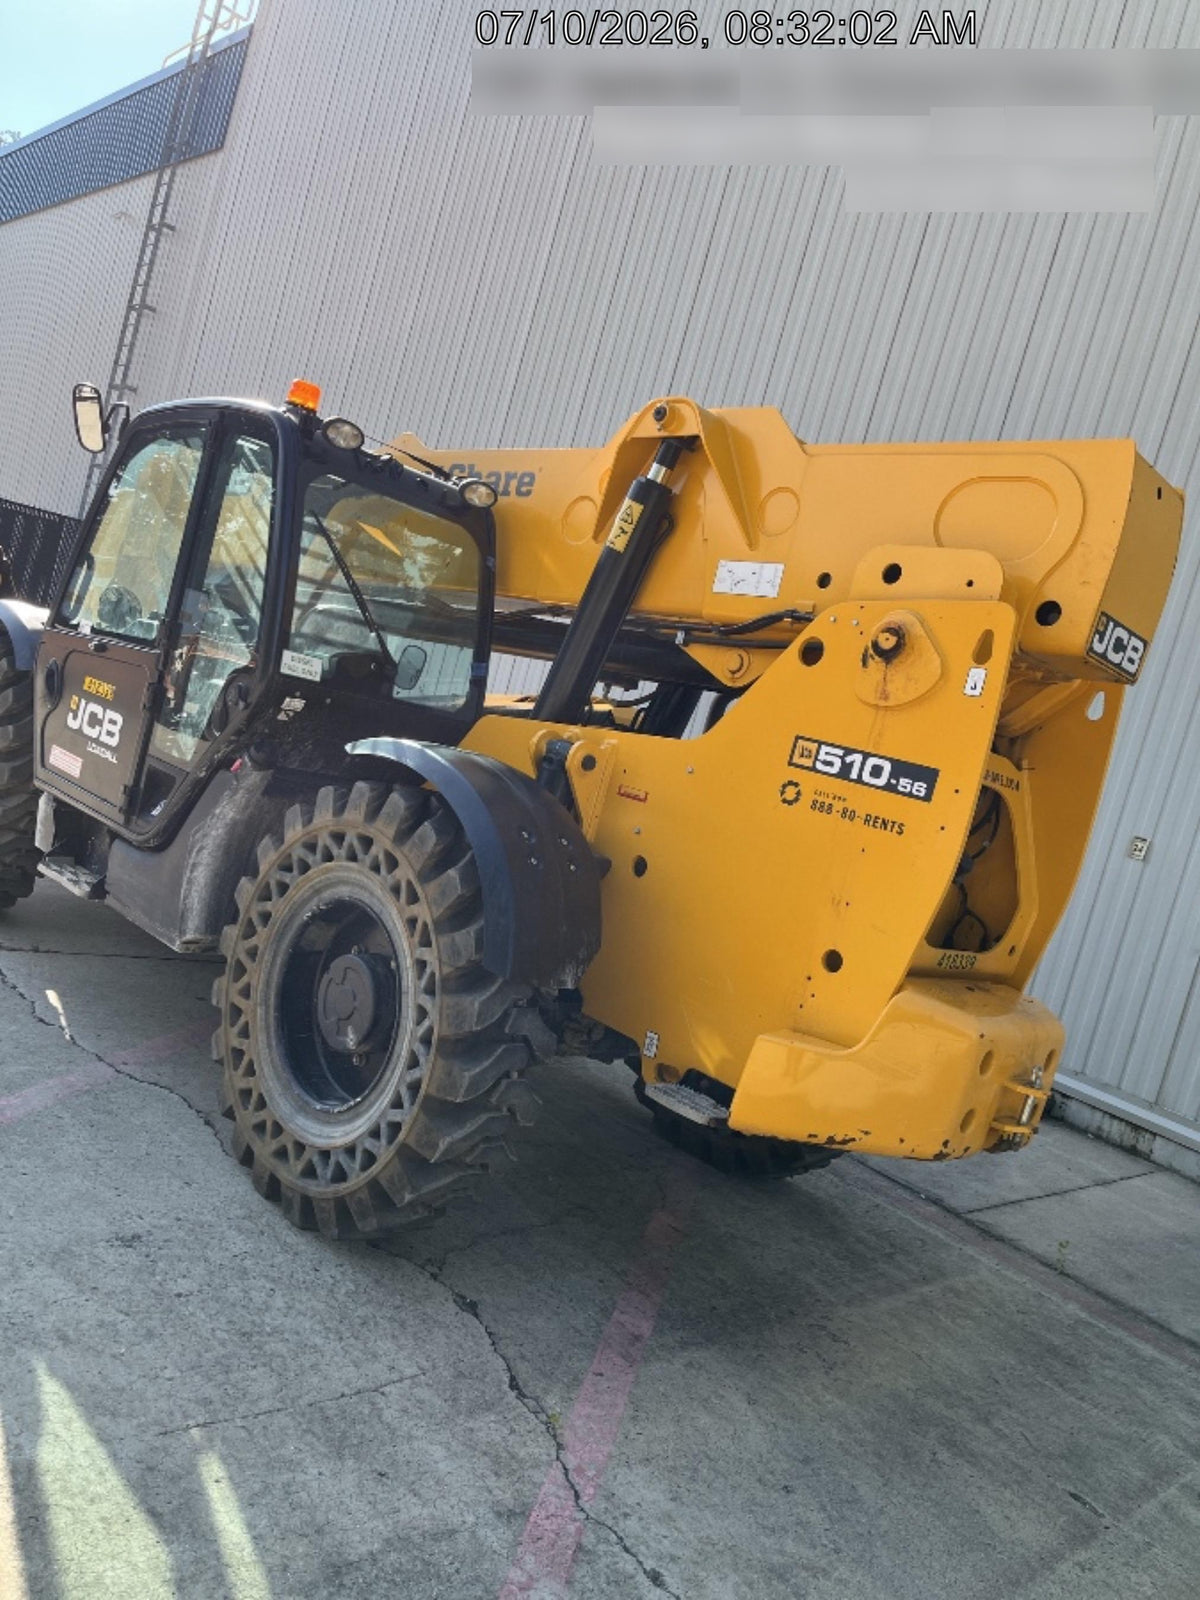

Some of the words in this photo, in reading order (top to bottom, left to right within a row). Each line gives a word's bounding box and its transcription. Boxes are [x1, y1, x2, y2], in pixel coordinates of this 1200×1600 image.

[1092, 621, 1144, 674] JCB
[66, 698, 123, 748] JCB
[810, 799, 905, 836] 888-80-RENTS
